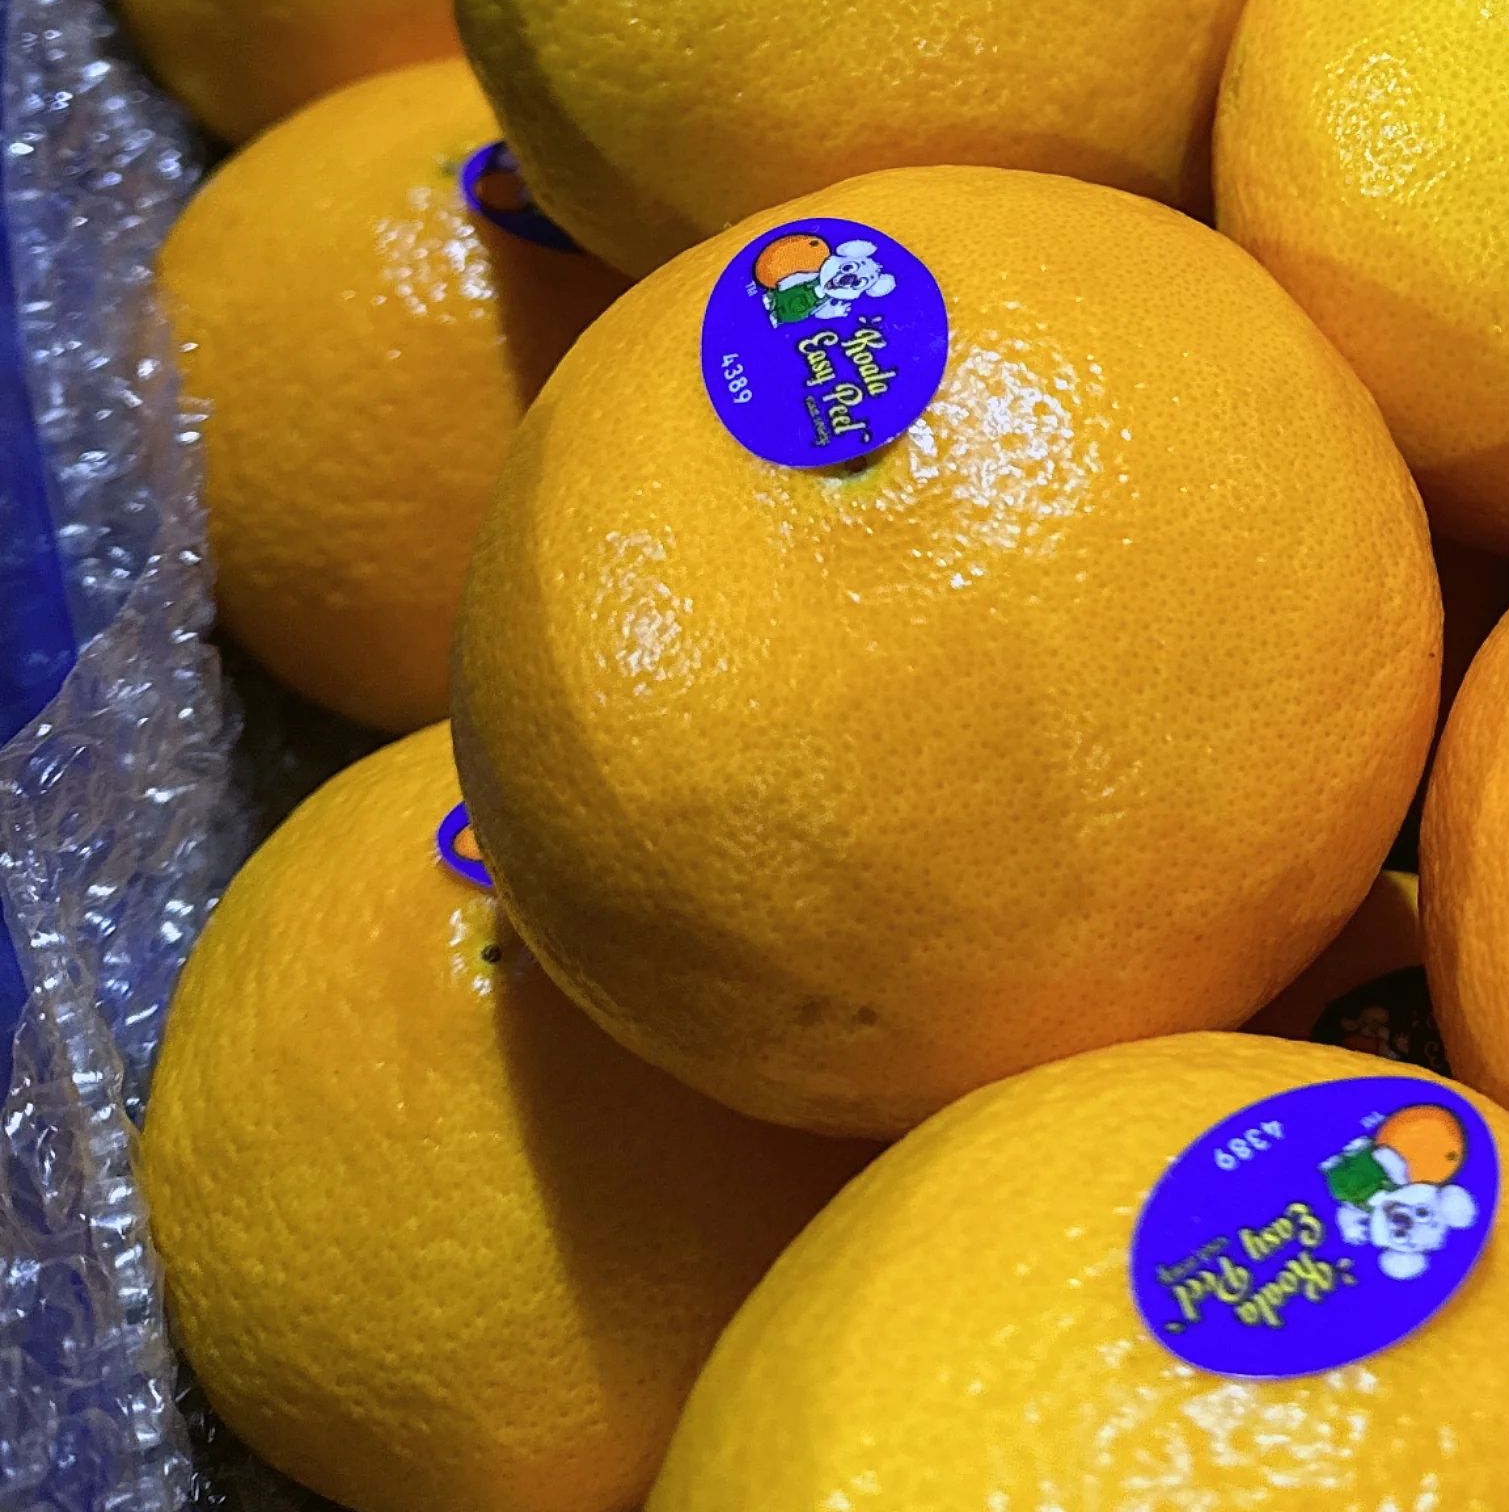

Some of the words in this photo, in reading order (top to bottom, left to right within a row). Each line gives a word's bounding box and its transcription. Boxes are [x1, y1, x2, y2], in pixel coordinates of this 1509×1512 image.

[721, 352, 753, 404] 4389
[798, 331, 840, 387] Easy
[822, 383, 867, 435] Peel
[841, 328, 897, 396] Koala
[1214, 1120, 1285, 1170] 4389
[1239, 1202, 1324, 1261] Easy
[1174, 1255, 1252, 1322] Peel
[1235, 1251, 1335, 1328] Koala
